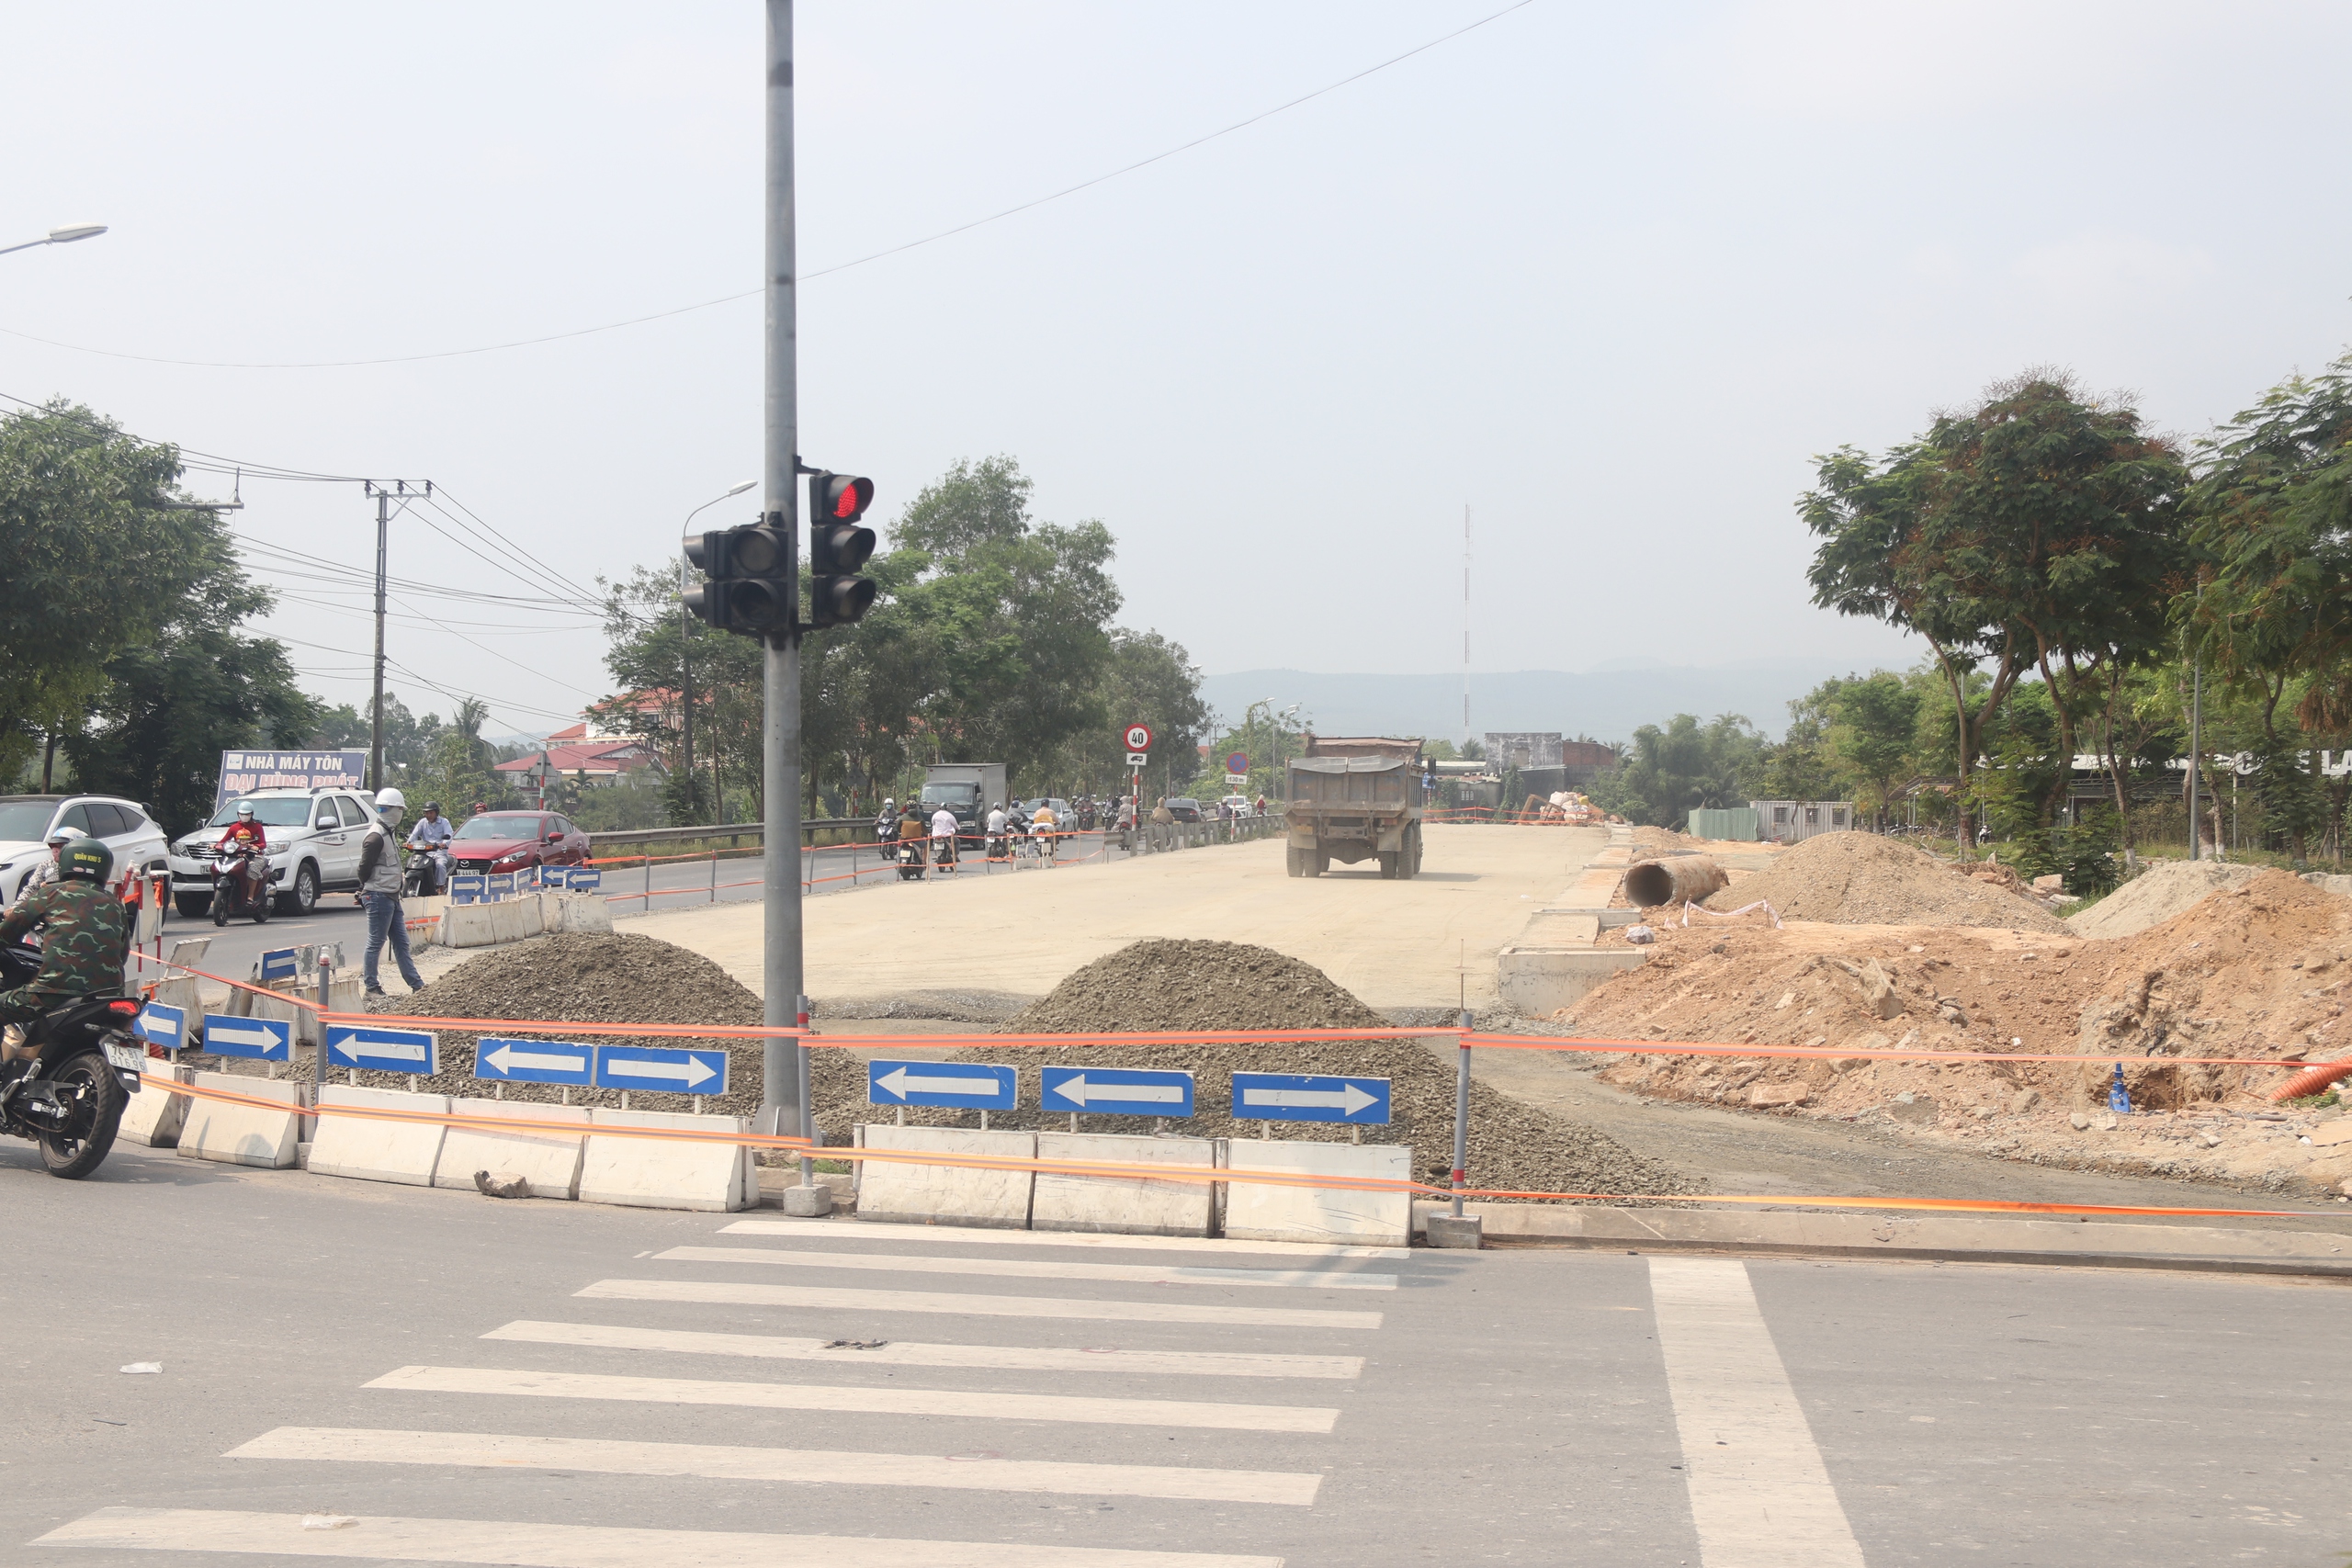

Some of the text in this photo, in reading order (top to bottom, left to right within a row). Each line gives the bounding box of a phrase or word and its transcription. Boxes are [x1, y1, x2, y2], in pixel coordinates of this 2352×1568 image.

[1132, 732, 1143, 744] 40
[245, 753, 343, 770] NHÀ MÁY TÔN
[224, 773, 256, 795] ĐẠI
[311, 773, 359, 791] PHÁT
[74, 852, 86, 861] QUÂN
[87, 854, 96, 863] KHU
[110, 1055, 145, 1071] 316.96
